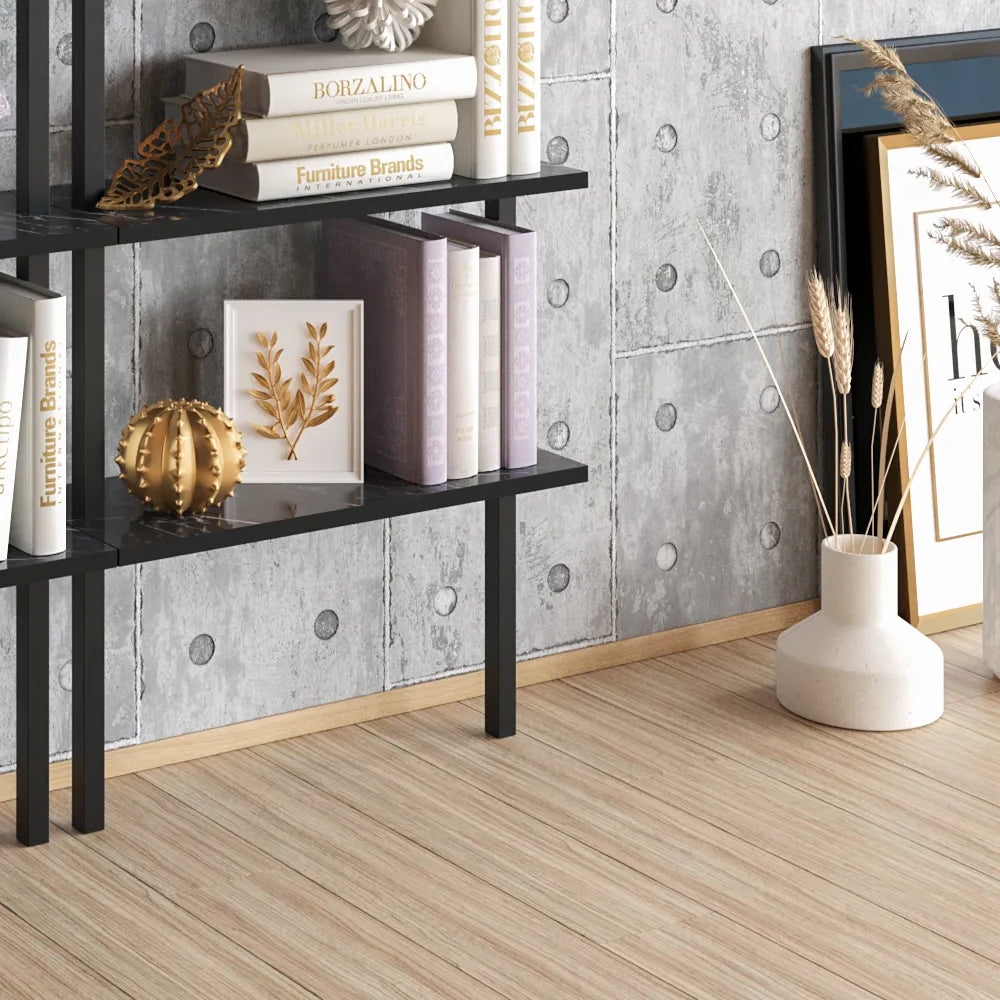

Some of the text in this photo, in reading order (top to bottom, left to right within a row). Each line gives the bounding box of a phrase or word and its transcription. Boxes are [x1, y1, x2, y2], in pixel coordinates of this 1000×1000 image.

[312, 72, 427, 100] BORZALINO
[366, 134, 412, 146] LONDON
[296, 155, 424, 184] Furniture Brands
[296, 173, 423, 192] INTERNATIONAL
[40, 340, 57, 508] Furniture Brands
